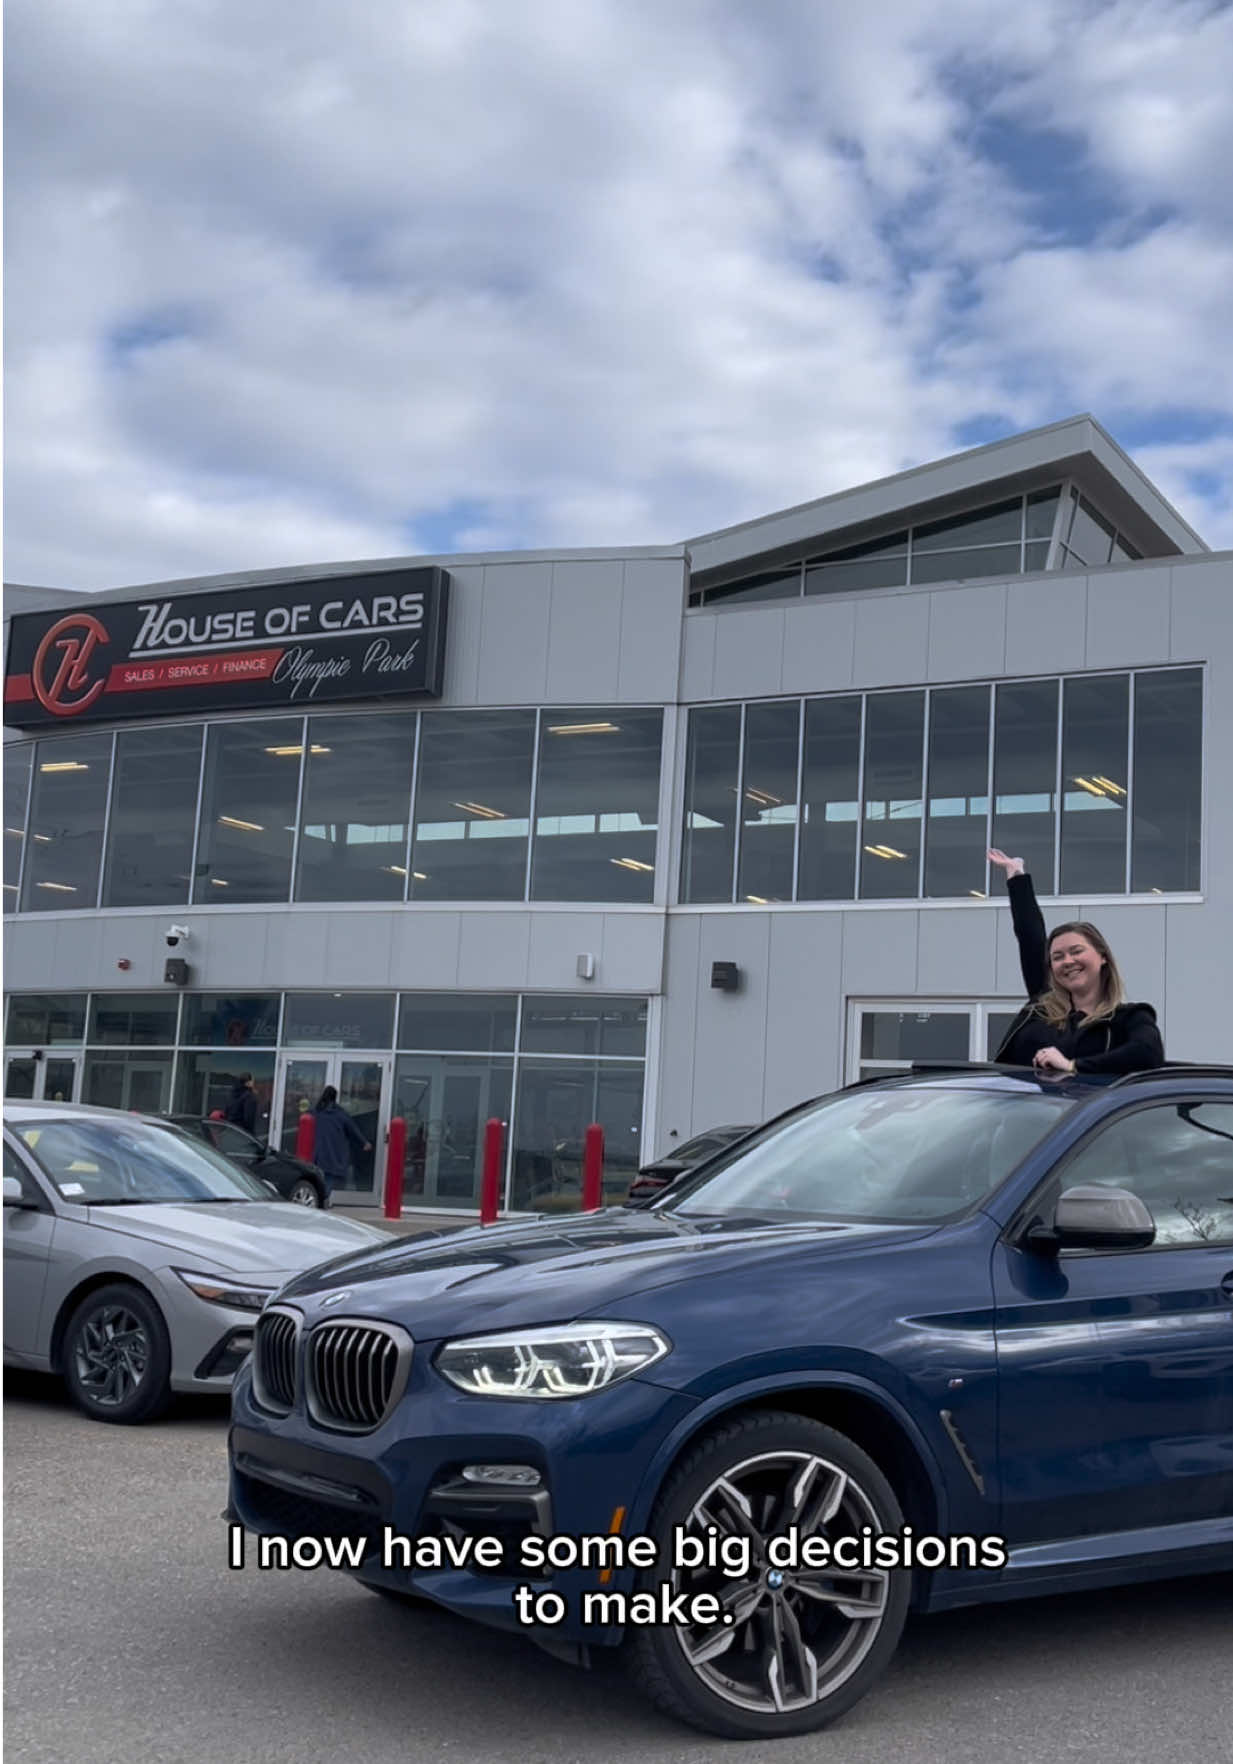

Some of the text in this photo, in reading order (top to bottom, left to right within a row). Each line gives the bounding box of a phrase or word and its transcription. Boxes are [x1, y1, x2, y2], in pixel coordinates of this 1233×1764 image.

[132, 592, 425, 649] HOUSE OF CARS
[124, 668, 155, 682] SALES
[168, 664, 209, 679] SERVICE
[223, 658, 267, 673] FINANCE
[272, 637, 420, 699] Olympic Park
